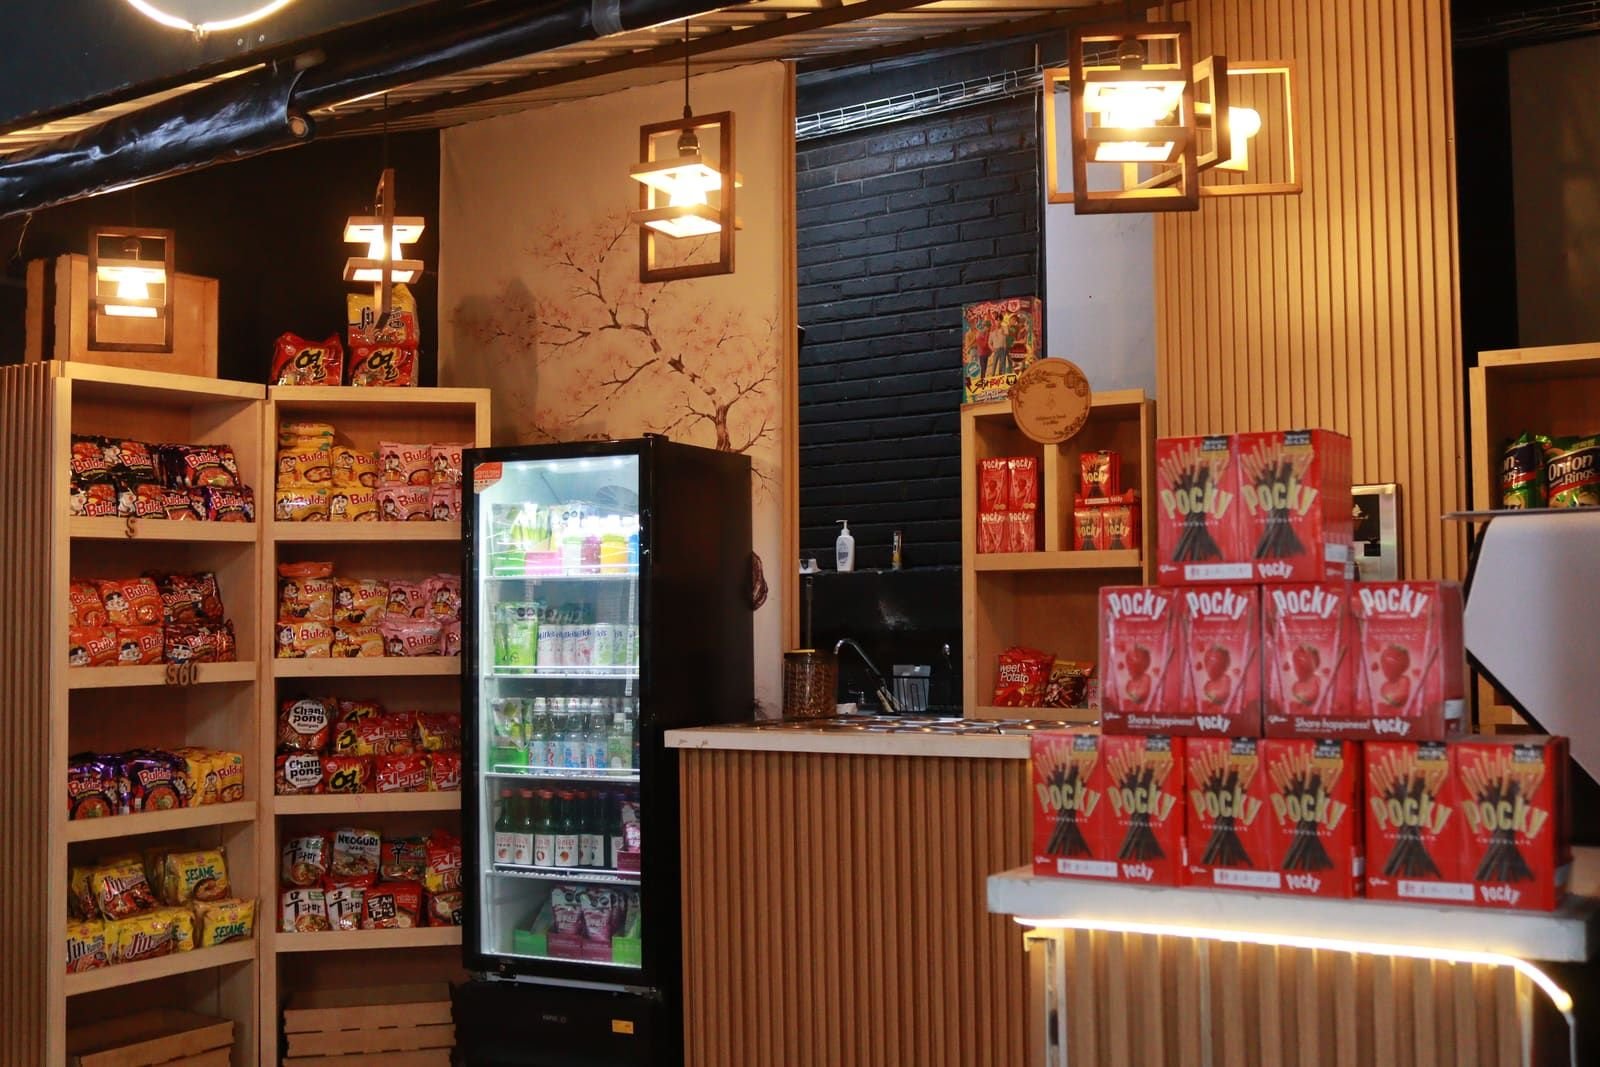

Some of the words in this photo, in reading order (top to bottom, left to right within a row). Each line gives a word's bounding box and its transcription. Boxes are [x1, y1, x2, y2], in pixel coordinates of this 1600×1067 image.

[295, 350, 326, 380] 열
[367, 350, 399, 380] 열
[1548, 455, 1593, 482] Onion
[1000, 664, 1021, 673] weet
[1000, 672, 1030, 683] Potato
[293, 715, 324, 724] pong
[289, 759, 321, 769] Cham
[290, 768, 321, 778] pong
[337, 834, 379, 846] NEOGURI
[185, 865, 215, 882] SESAME
[213, 922, 246, 938] SESAME
